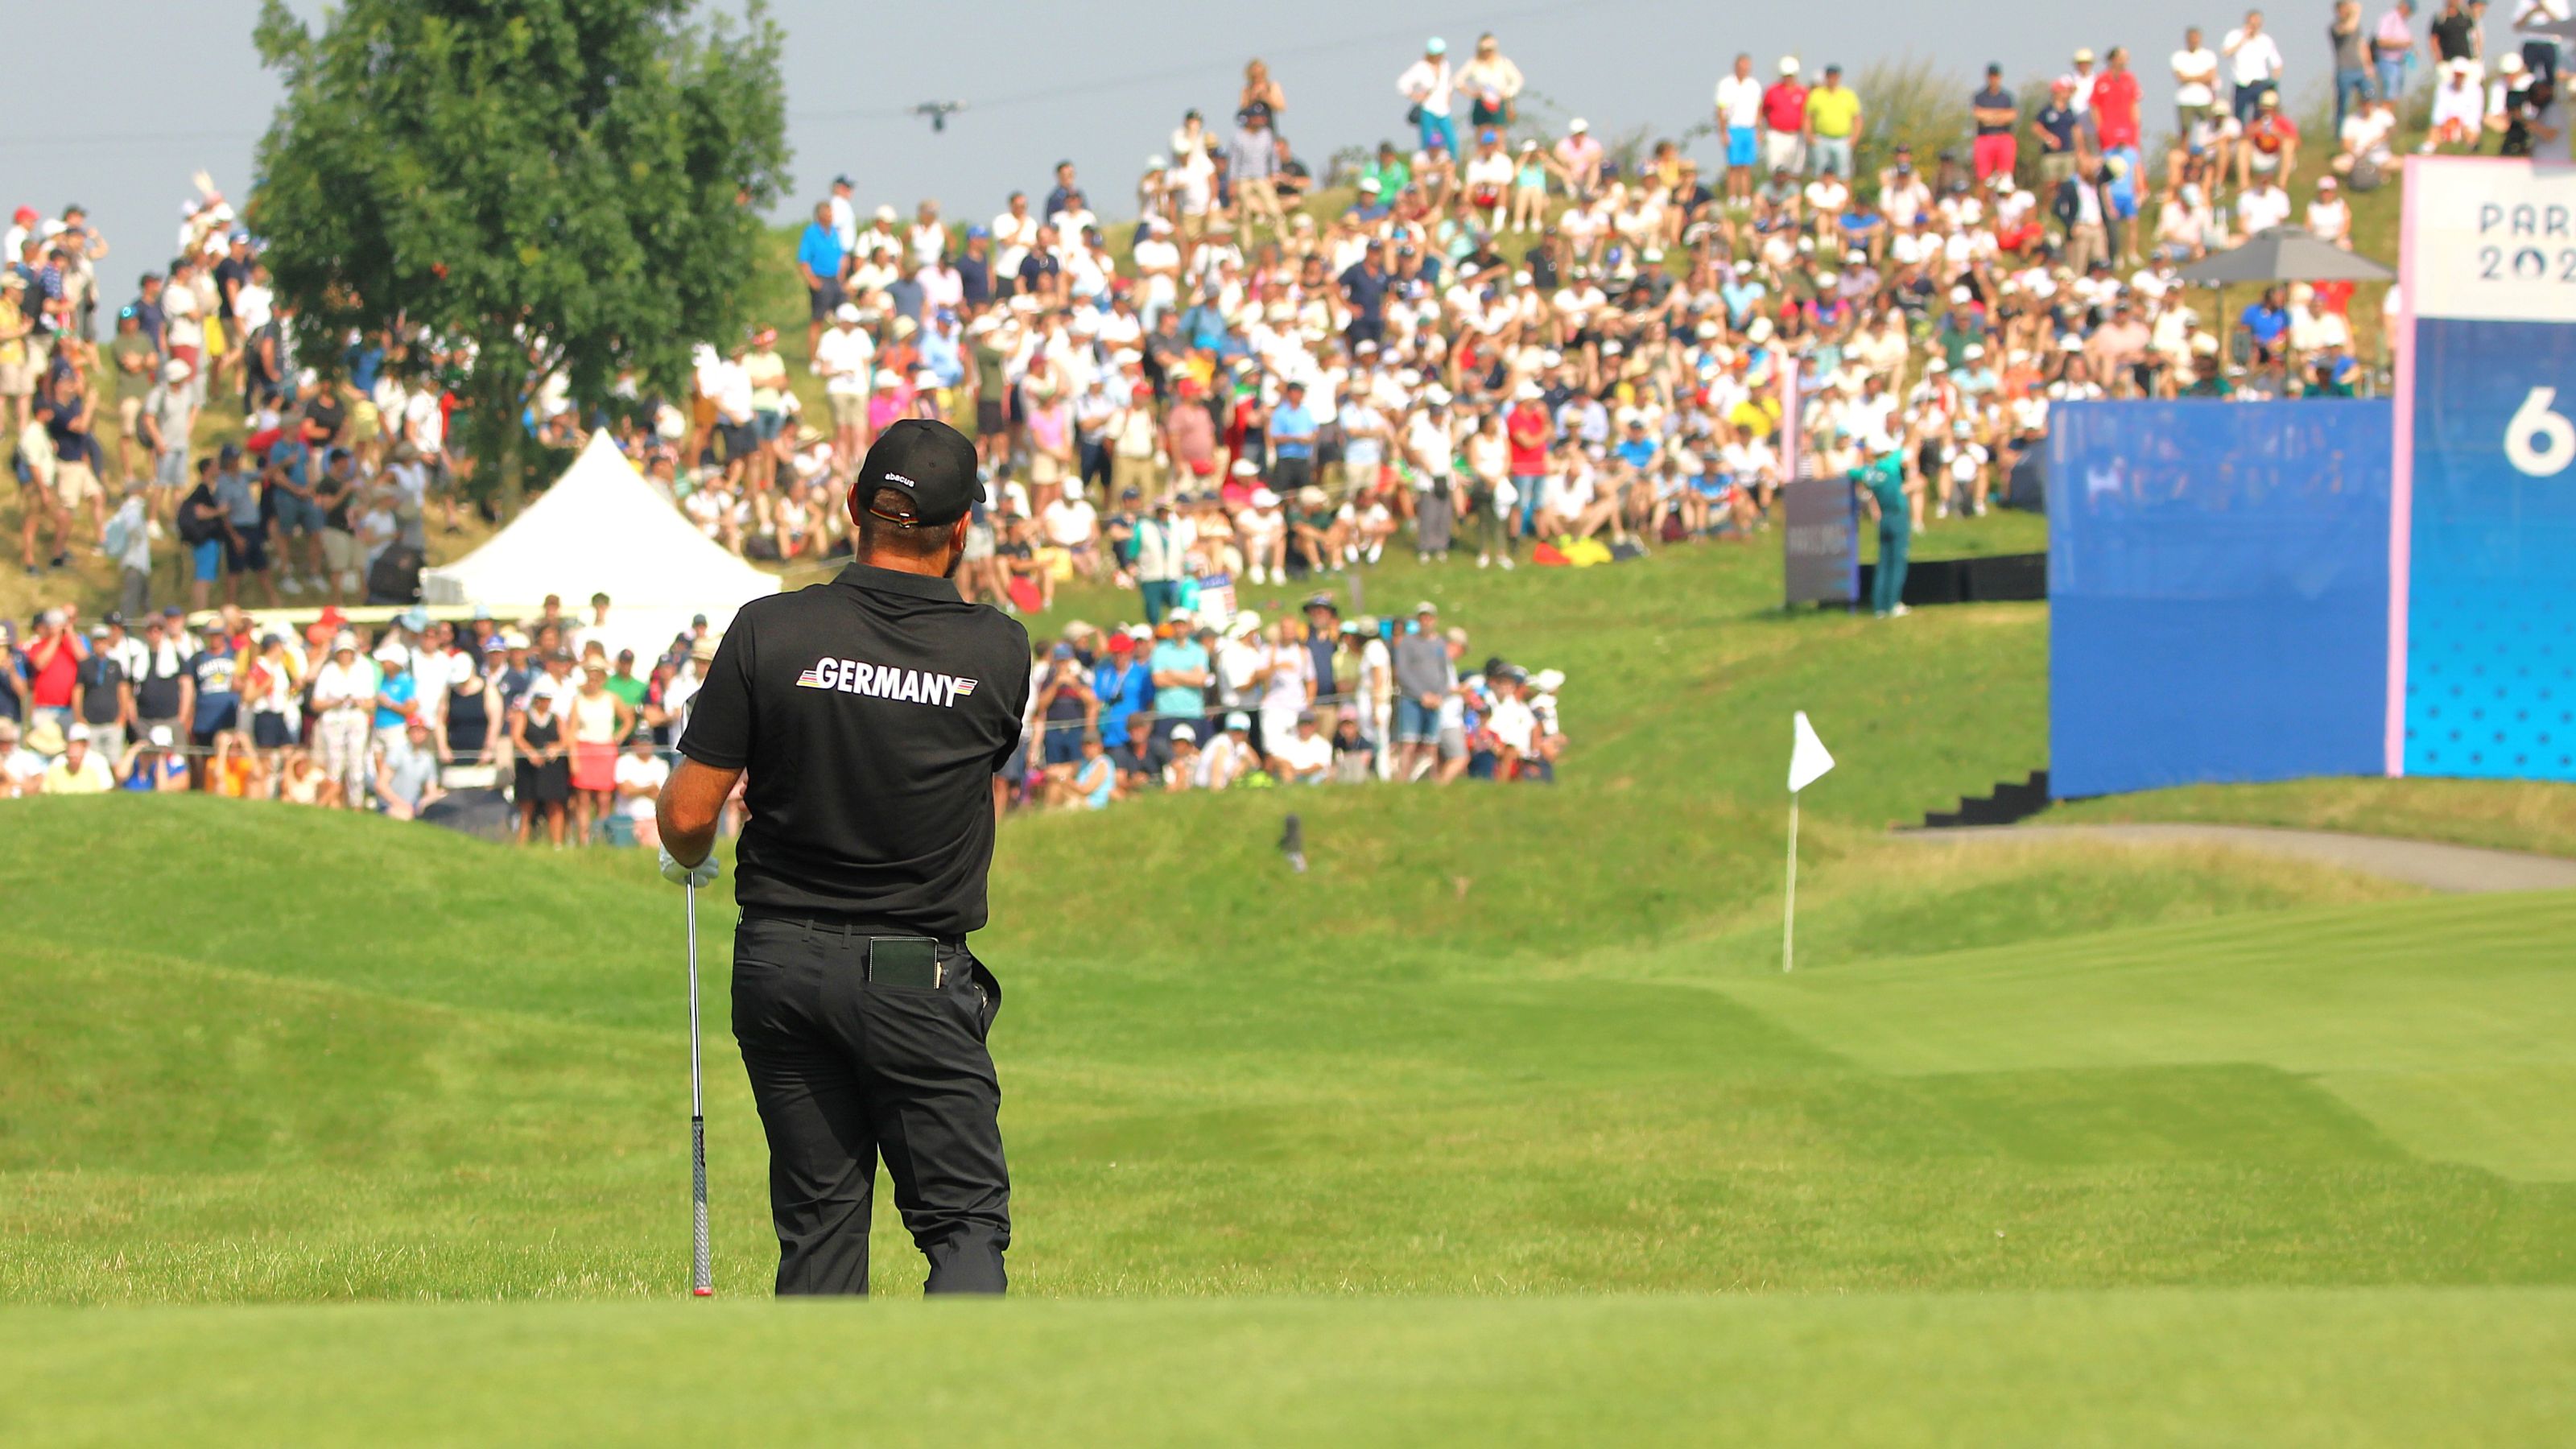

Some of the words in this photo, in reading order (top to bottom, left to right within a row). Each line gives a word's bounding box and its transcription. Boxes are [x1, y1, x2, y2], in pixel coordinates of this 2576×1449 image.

[2504, 386, 2576, 477] 6
[885, 472, 915, 488] abacus
[815, 656, 962, 708] GERMANY
